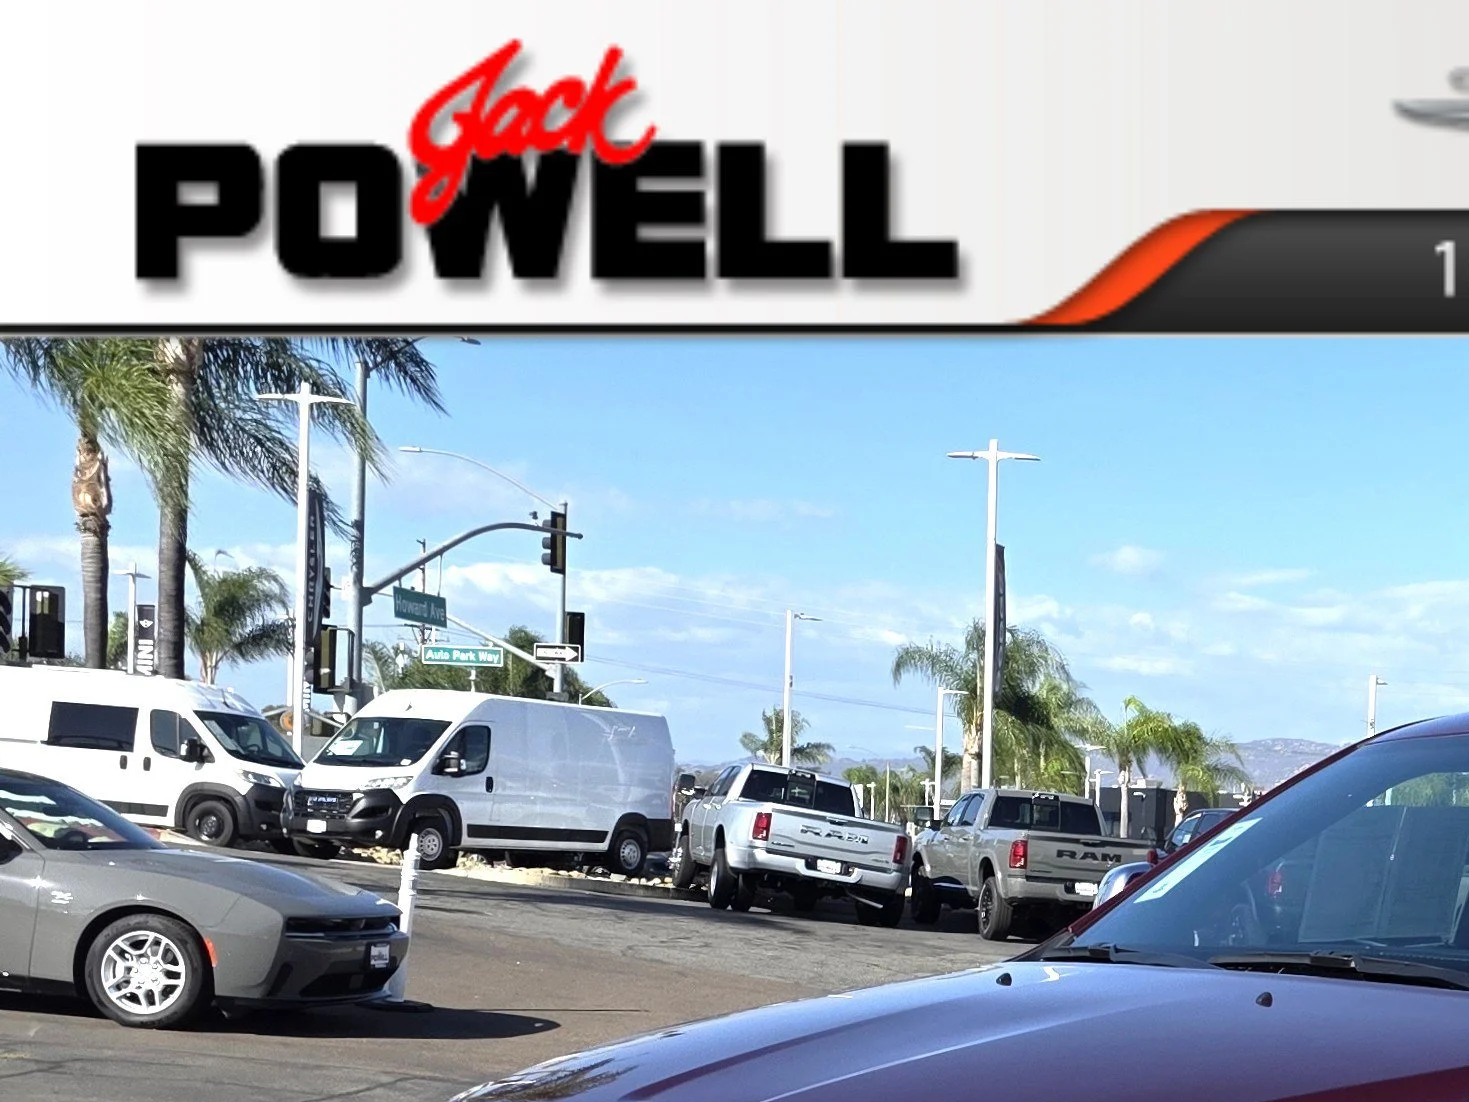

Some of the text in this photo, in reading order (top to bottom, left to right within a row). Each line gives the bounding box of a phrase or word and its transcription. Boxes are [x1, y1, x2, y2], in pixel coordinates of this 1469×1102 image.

[395, 594, 446, 621] Howard Ave
[425, 649, 500, 664] Auto Park Way
[800, 824, 869, 845] RAM
[1056, 849, 1122, 863] RAM
